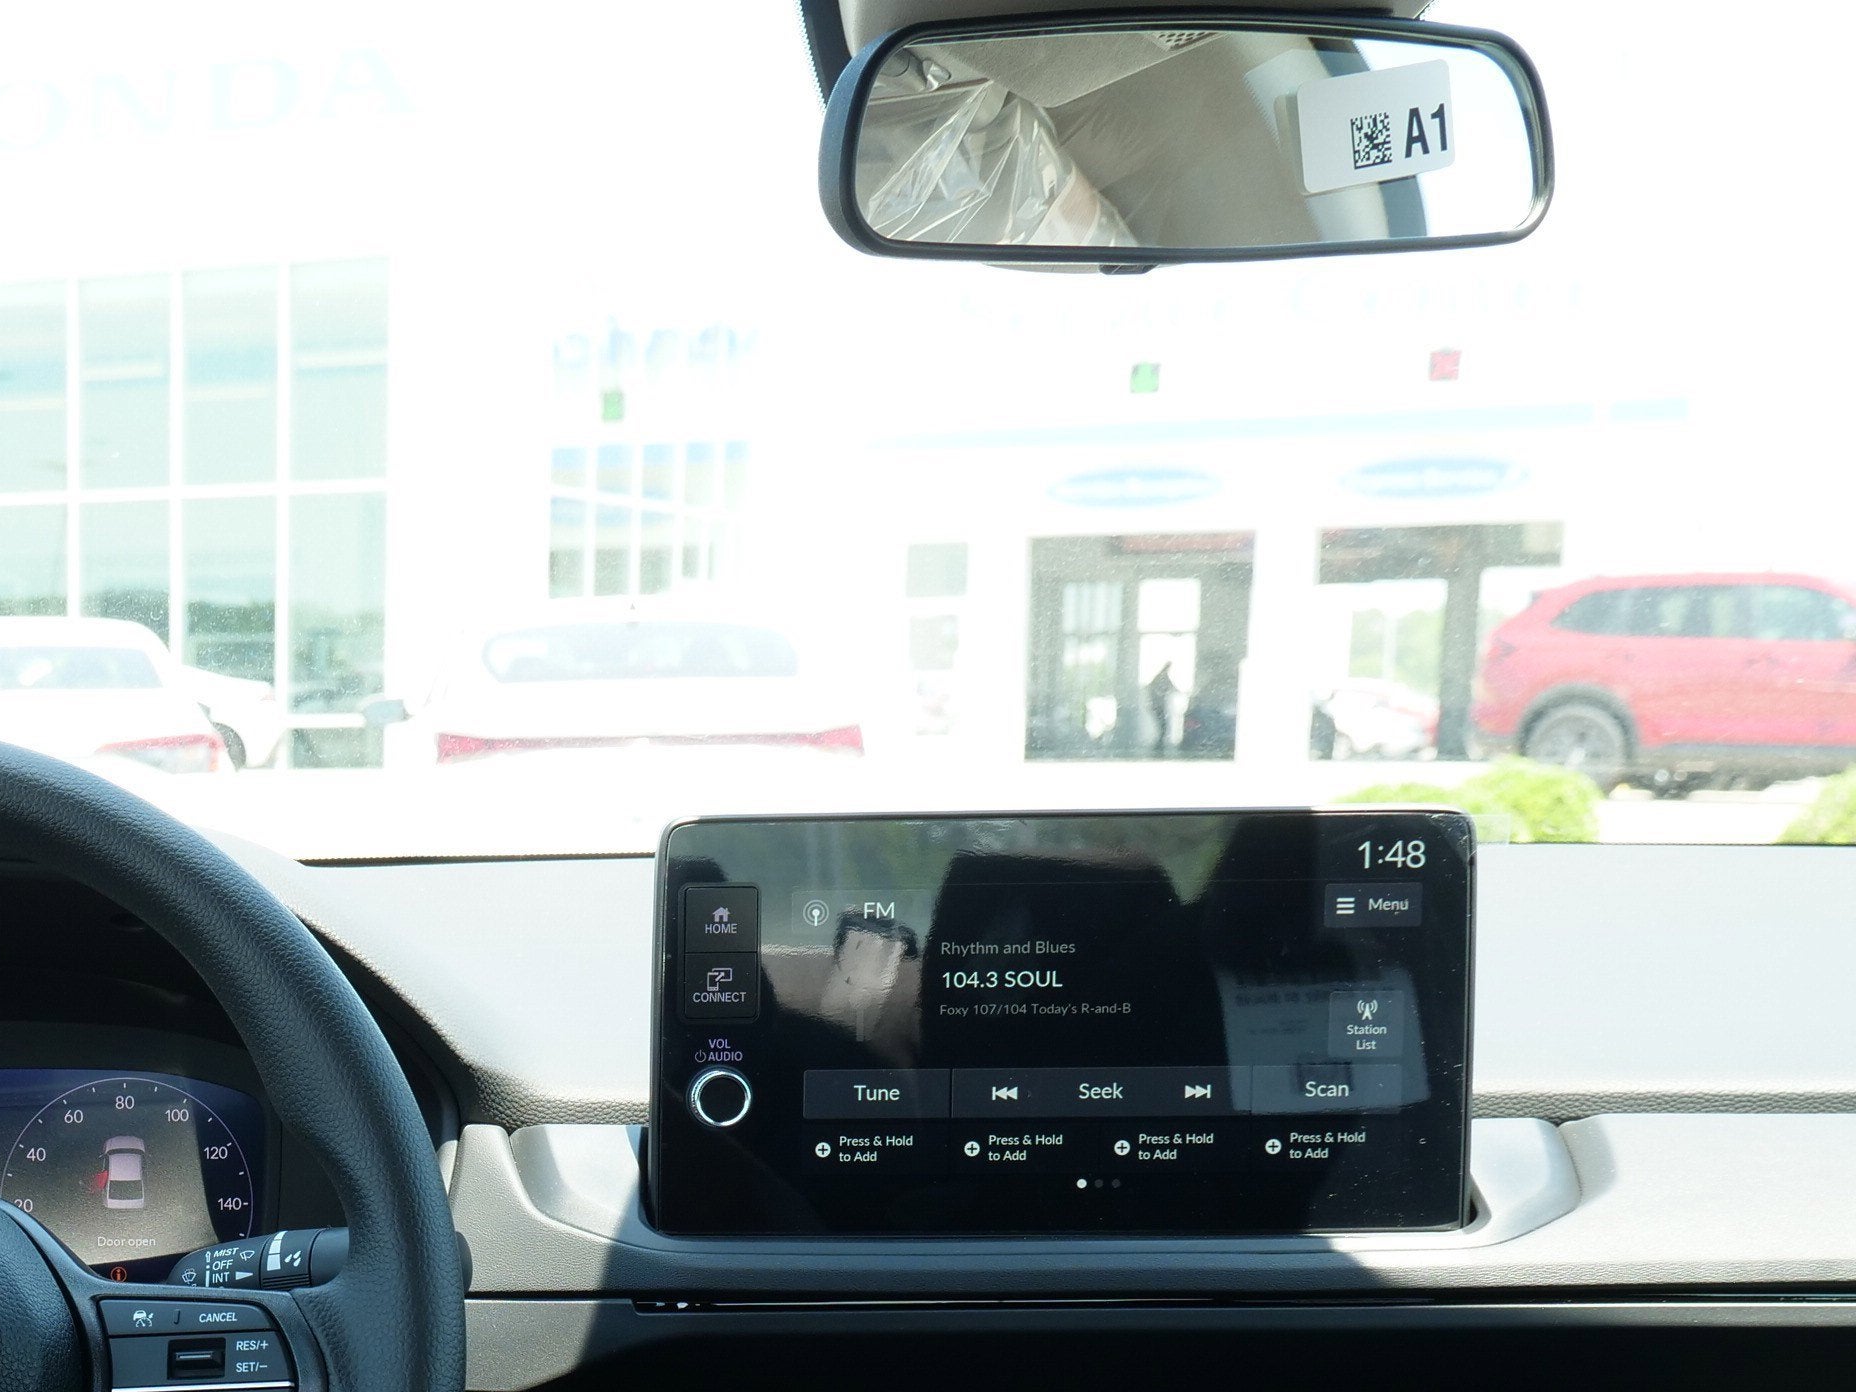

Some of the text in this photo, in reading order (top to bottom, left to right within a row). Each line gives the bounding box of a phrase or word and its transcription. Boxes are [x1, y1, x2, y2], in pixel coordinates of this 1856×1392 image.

[1405, 102, 1448, 158] A1
[1357, 840, 1426, 869] 1:48
[863, 902, 895, 919] FM
[1368, 898, 1408, 911] Menu
[705, 924, 738, 934] HOME
[941, 941, 1076, 958] Rhythm and Blues
[942, 971, 1063, 988] 104.3 SOUL
[692, 992, 747, 1003] CONNECT
[940, 1003, 1131, 1017] Foxy 107/104 Today's R-and-B
[1346, 1024, 1387, 1035] Station
[708, 1039, 731, 1049] VOL
[1356, 1040, 1377, 1050] List
[708, 1052, 743, 1062] AUDIO
[854, 1085, 900, 1101] Tune
[1078, 1082, 1124, 1099] Seek
[1305, 1081, 1349, 1097] Scan
[115, 1096, 135, 1110] 80
[64, 1110, 83, 1124] 60
[165, 1109, 189, 1123] 100
[839, 1135, 913, 1147] Press & Hold
[989, 1134, 1063, 1146] Press & Hold
[1138, 1133, 1214, 1144] Press & Hold
[1289, 1132, 1365, 1143] Press & Hold
[26, 1147, 46, 1162] 40
[204, 1146, 228, 1160] 120
[839, 1151, 877, 1162] to Add
[988, 1150, 1027, 1161] to Add
[1138, 1149, 1177, 1160] to Add
[1289, 1148, 1329, 1159] to Add
[14, 1199, 33, 1213] 20
[217, 1197, 242, 1211] 140
[97, 1236, 156, 1249] Door open
[213, 1247, 239, 1258] MIST
[212, 1259, 233, 1270] OFF
[212, 1272, 230, 1283] INT
[199, 1312, 238, 1323] CANCEL
[236, 1340, 268, 1351] RES/+
